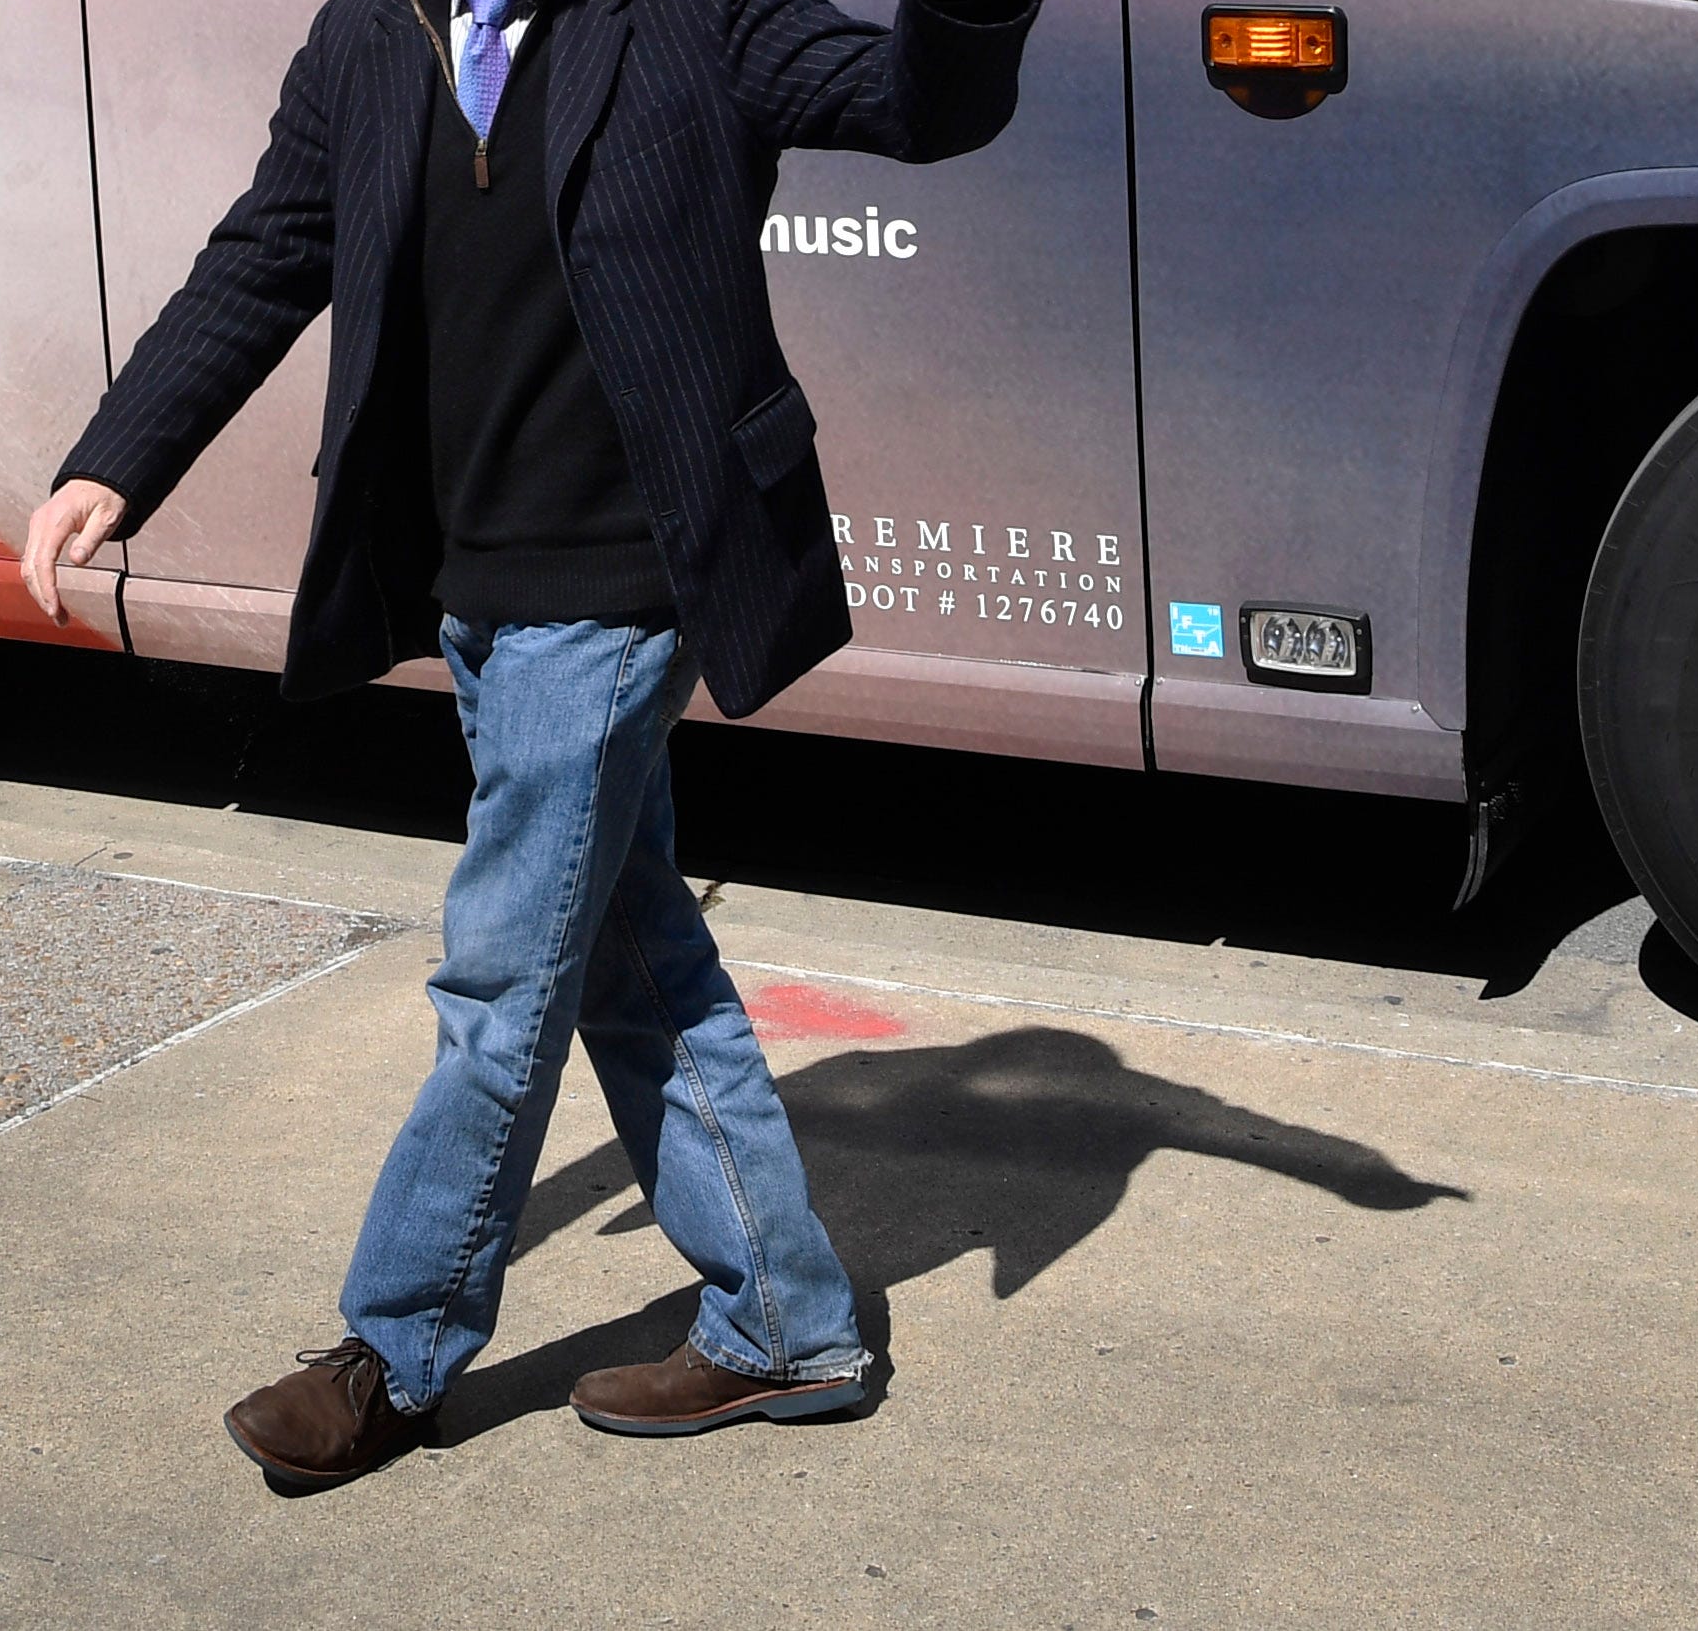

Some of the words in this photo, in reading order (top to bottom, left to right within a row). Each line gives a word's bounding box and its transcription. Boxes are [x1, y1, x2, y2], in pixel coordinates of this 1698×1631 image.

[829, 512, 1122, 567] REMIERE
[840, 553, 1122, 594] ANSPORTATION
[843, 581, 921, 613] DOT
[937, 588, 957, 617] #
[975, 592, 1124, 631] 1276740
